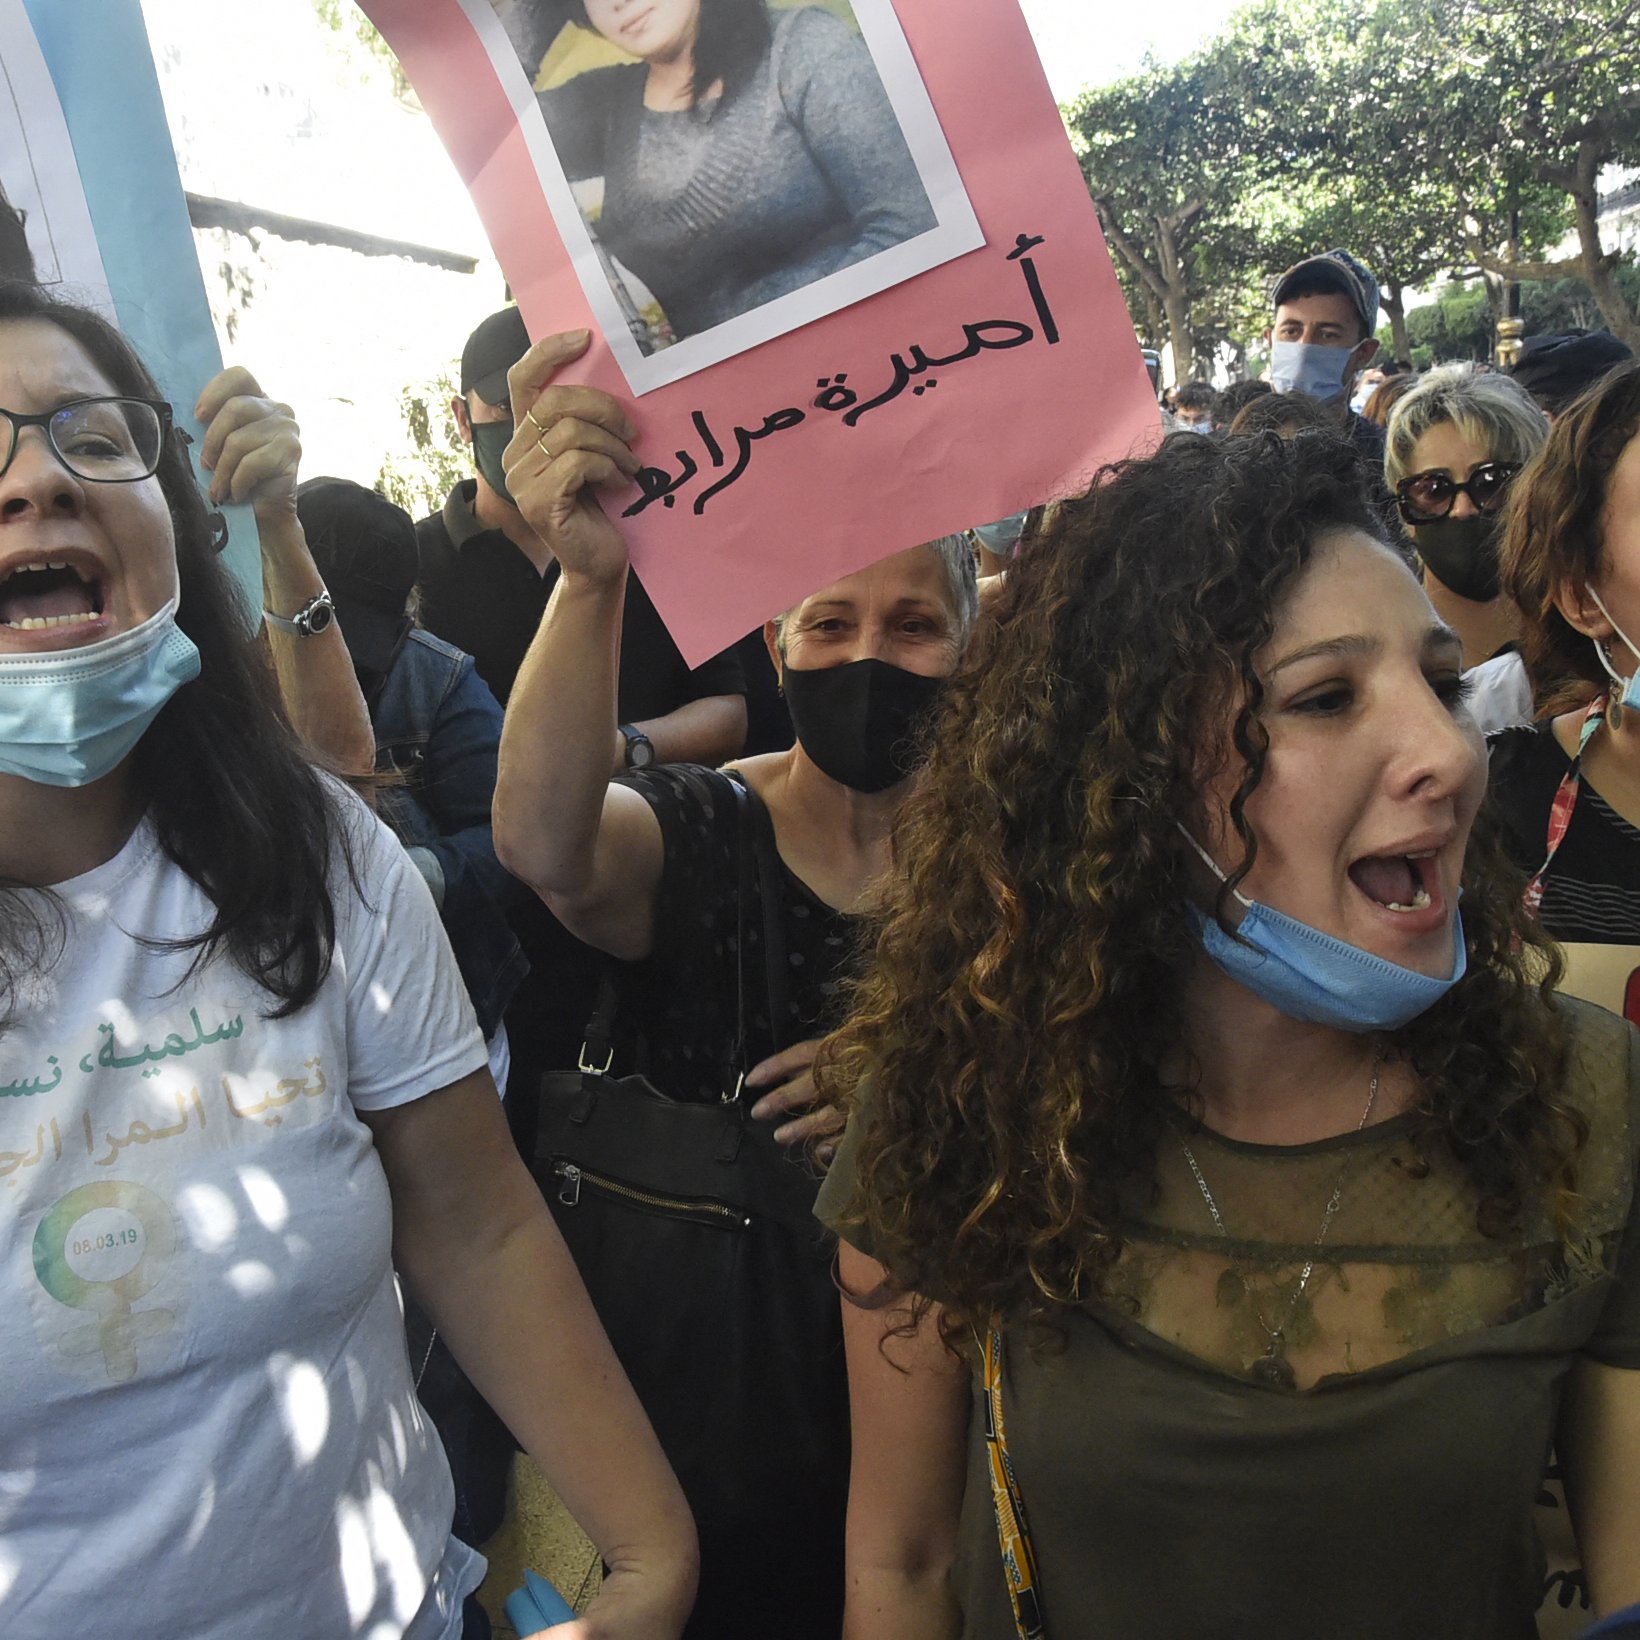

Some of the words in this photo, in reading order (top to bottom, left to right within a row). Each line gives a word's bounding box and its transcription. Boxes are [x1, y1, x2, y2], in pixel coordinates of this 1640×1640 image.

[813, 233, 1060, 427] أميرة
[222, 1056, 327, 1127] تحيا
[73, 1228, 138, 1255] 08.03.19
